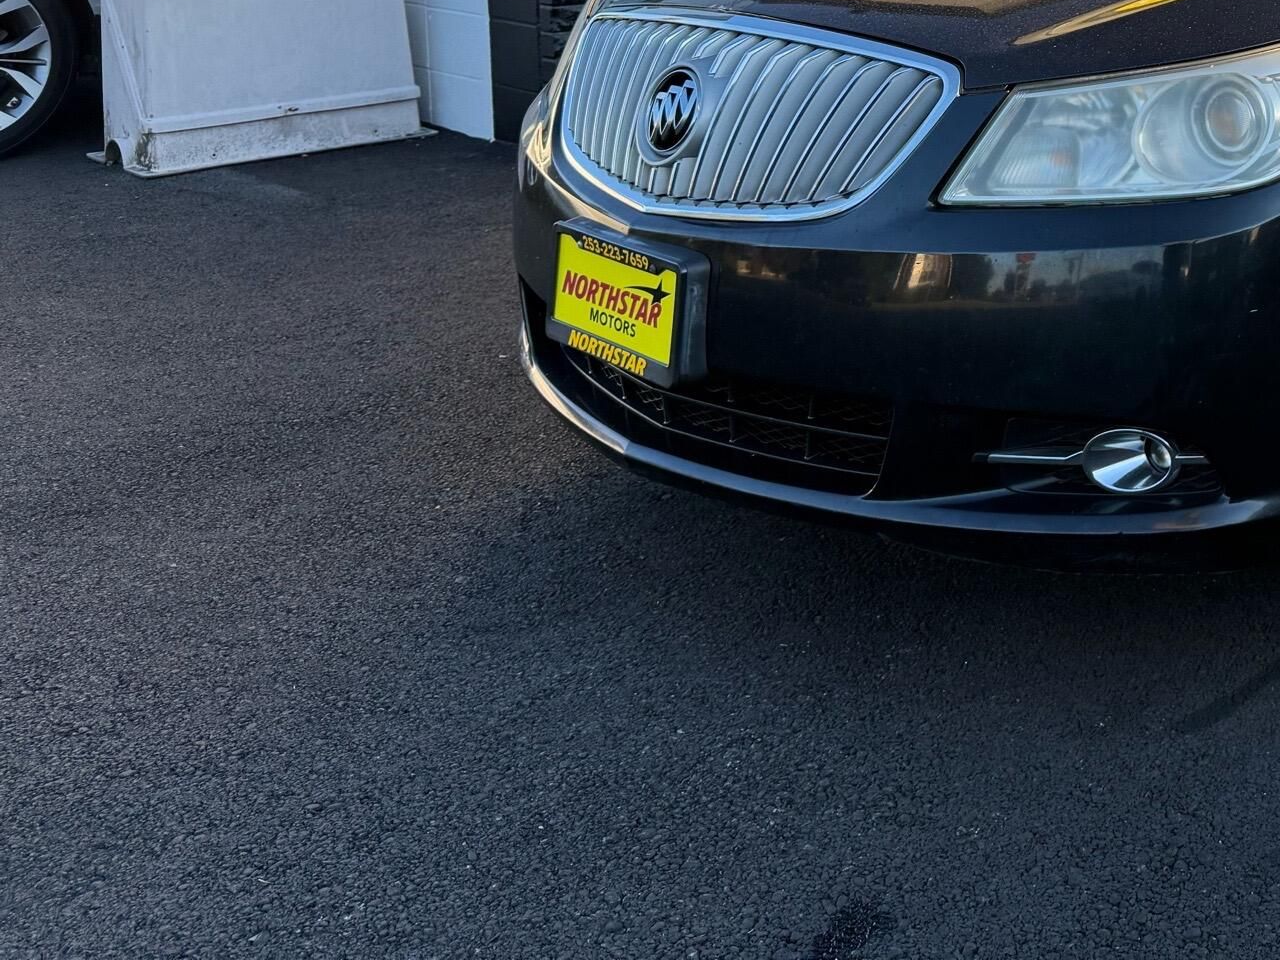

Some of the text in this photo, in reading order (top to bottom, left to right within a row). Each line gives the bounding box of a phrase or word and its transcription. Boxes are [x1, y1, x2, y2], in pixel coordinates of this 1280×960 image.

[582, 236, 649, 270] 253-223-7659
[562, 270, 662, 328] NORTHSTAR
[589, 307, 637, 338] MOTORS
[568, 329, 648, 377] NORTHSTAR
